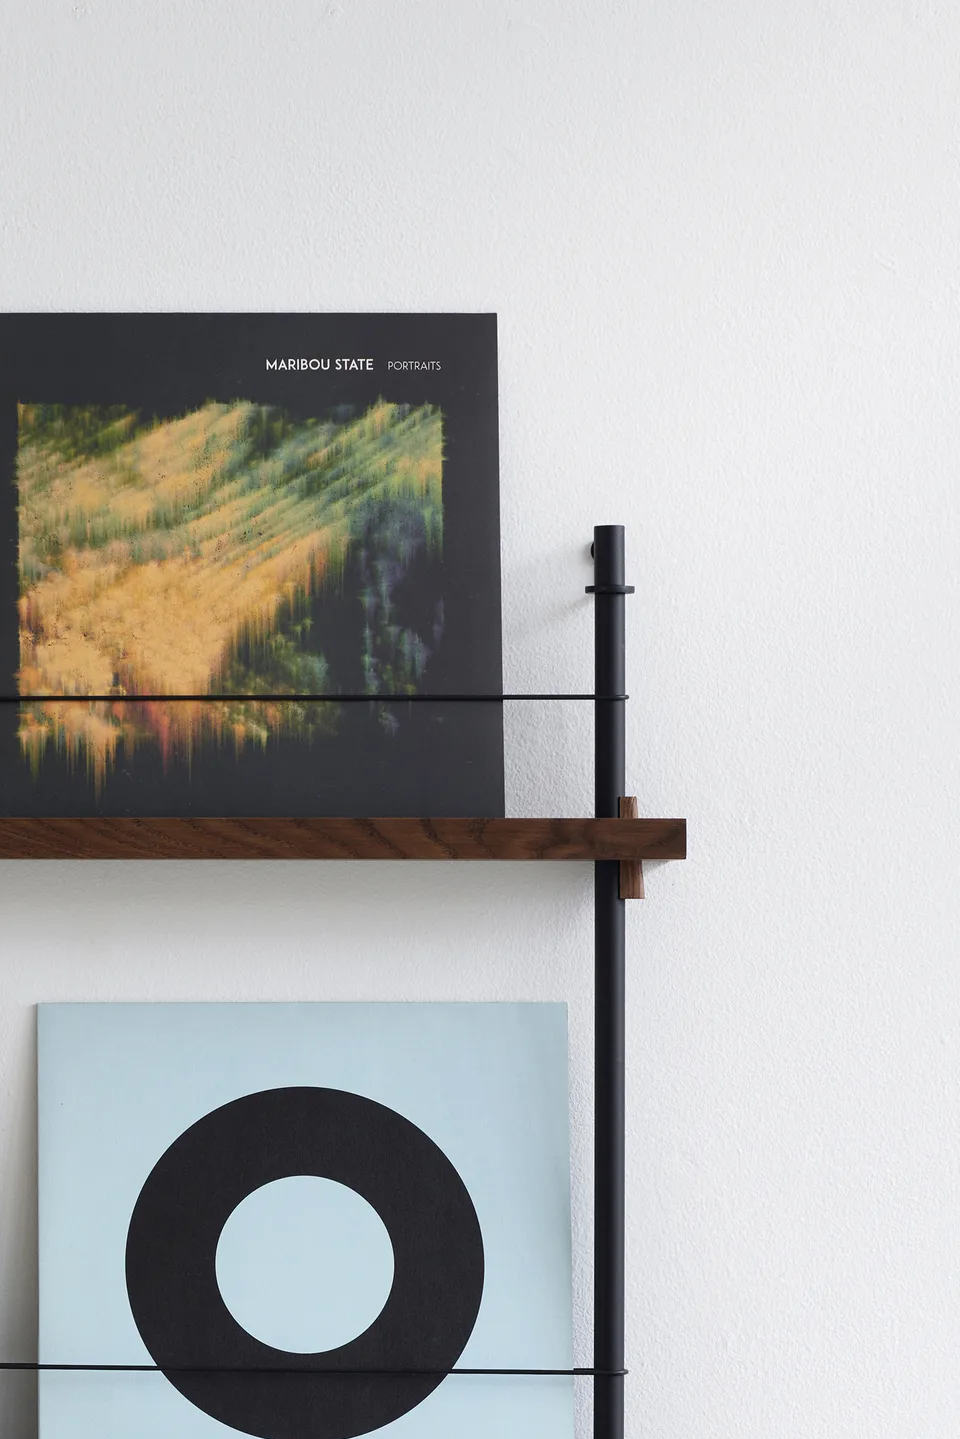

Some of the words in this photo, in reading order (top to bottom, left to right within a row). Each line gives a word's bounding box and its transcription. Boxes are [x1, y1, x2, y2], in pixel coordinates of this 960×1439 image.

[265, 358, 330, 371] MARIBOU
[335, 358, 374, 371] STATE
[387, 361, 442, 371] PORTRAITS
